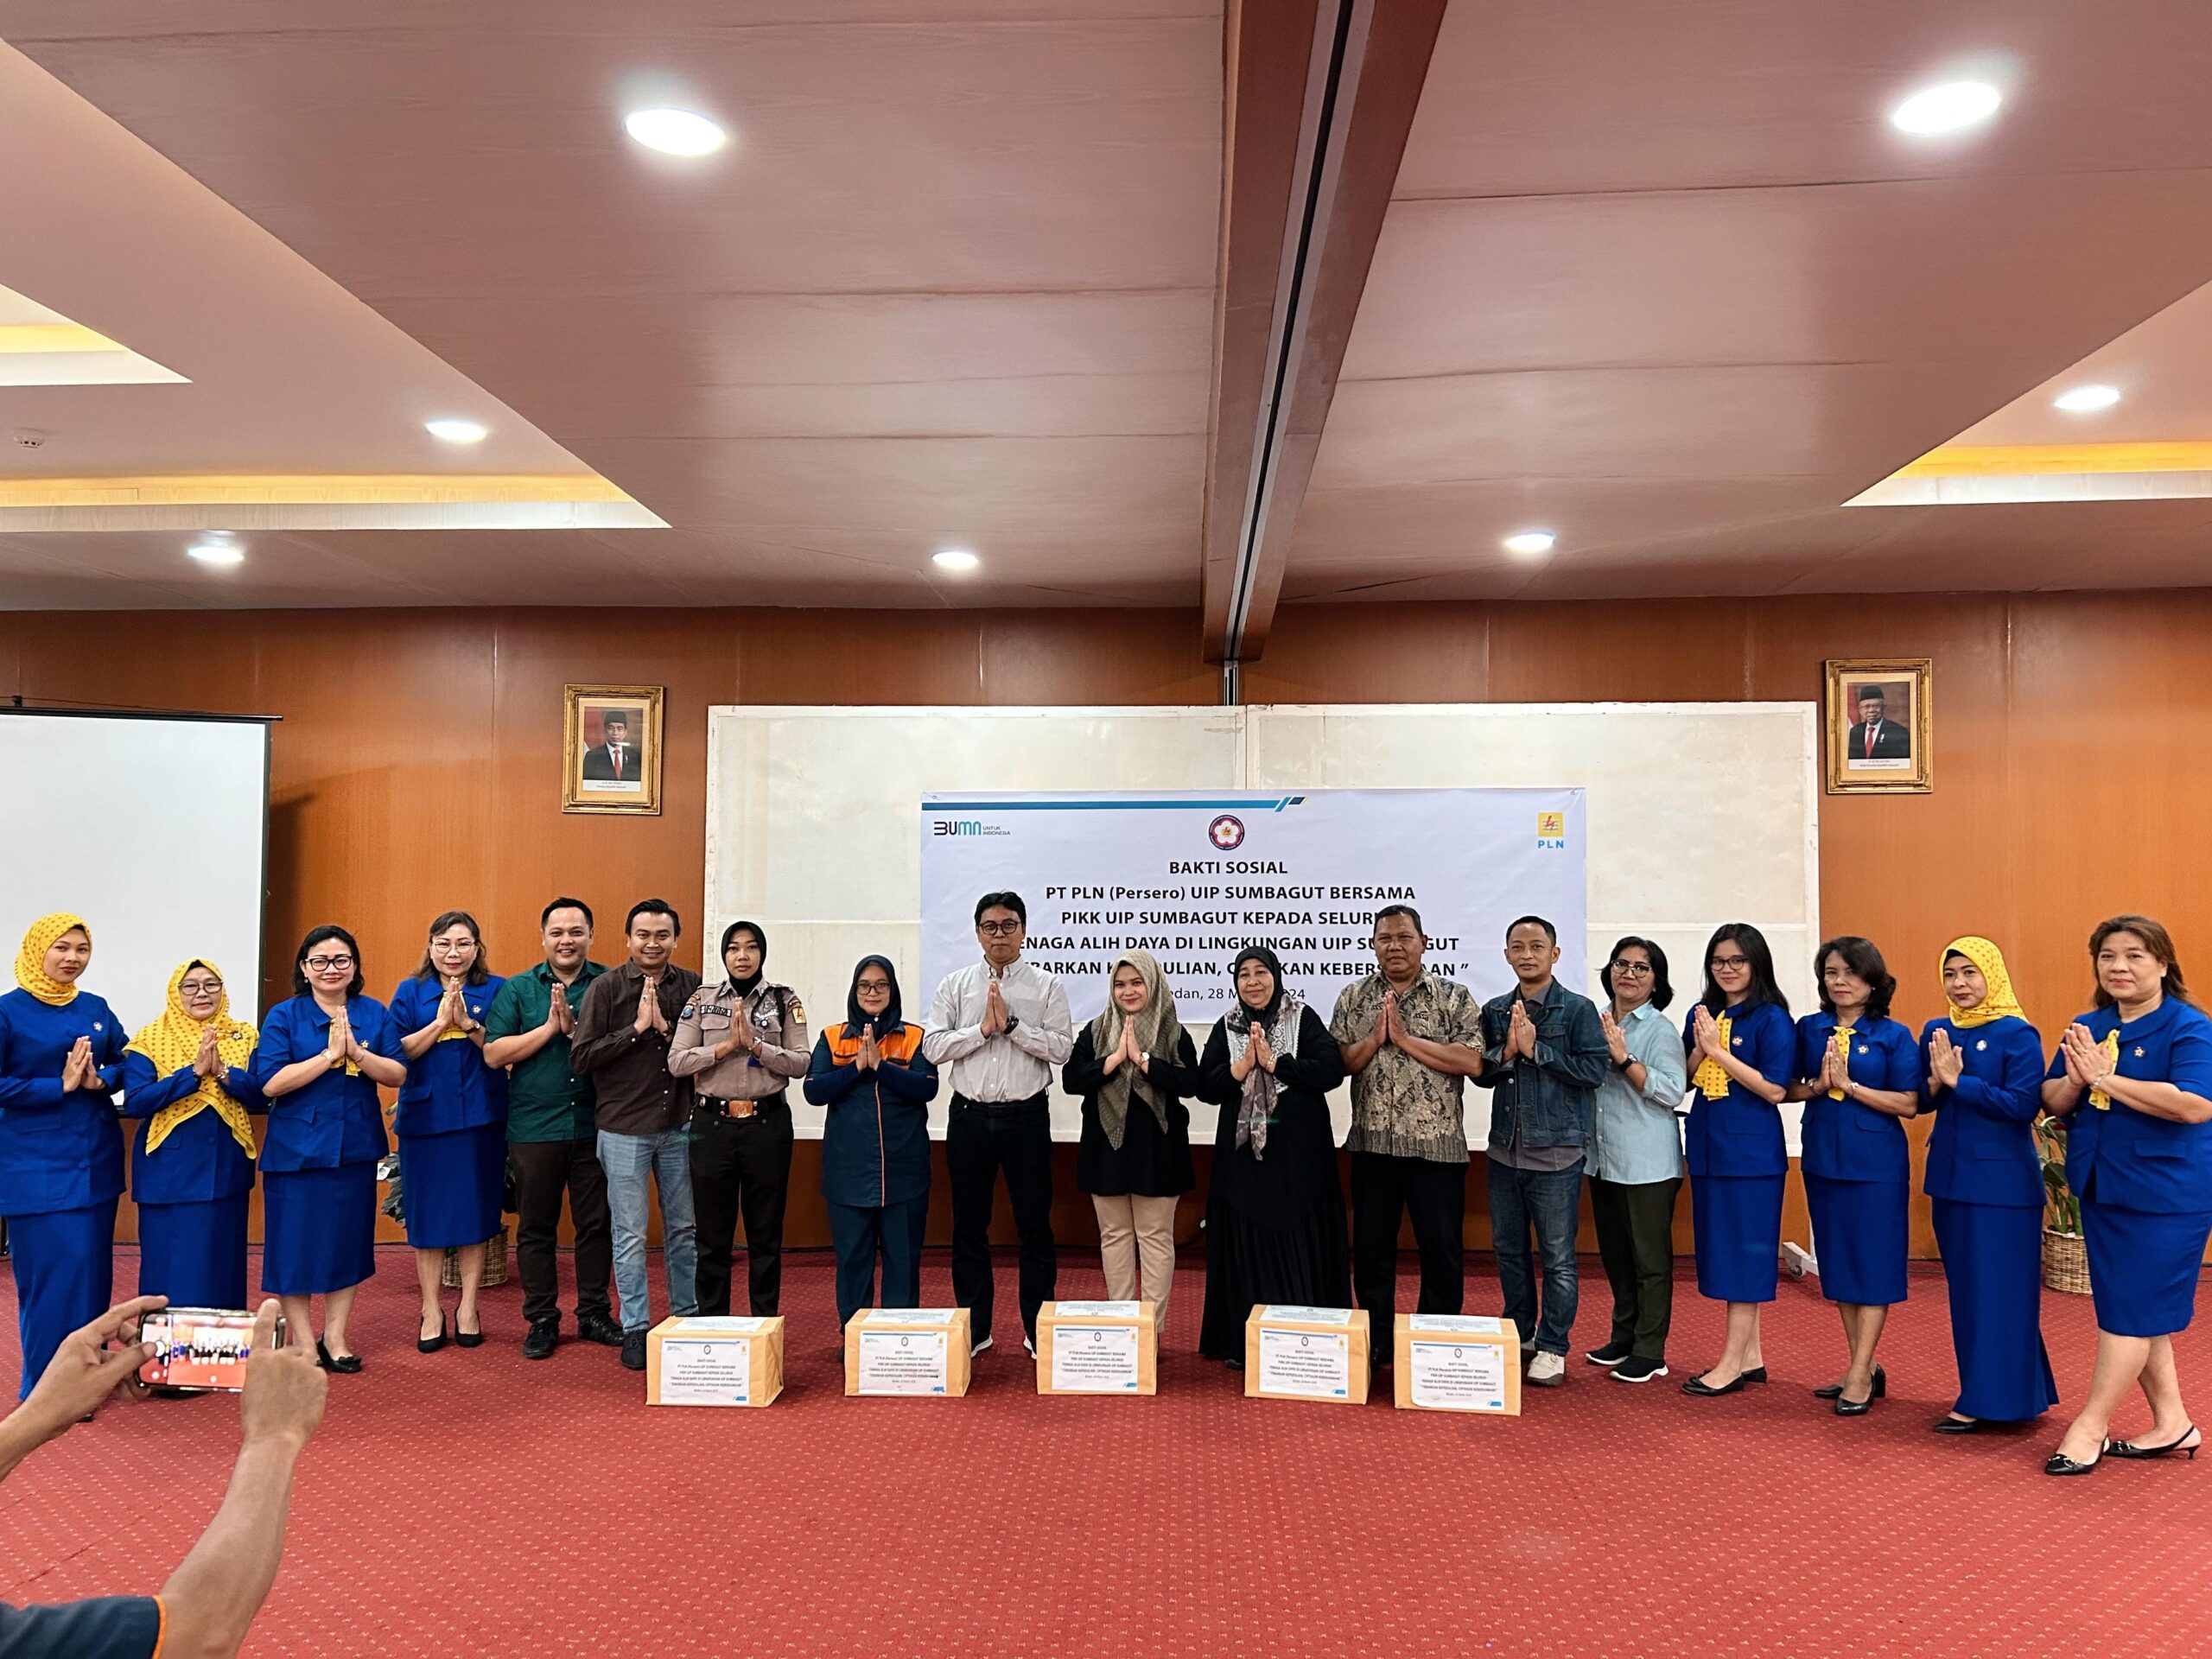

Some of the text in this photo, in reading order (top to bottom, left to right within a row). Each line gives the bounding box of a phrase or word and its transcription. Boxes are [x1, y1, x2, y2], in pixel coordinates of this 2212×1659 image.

[1537, 840, 1564, 849] PLN
[1169, 861, 1288, 874] BAKTI SOSIAL
[1046, 886, 1415, 901] PT PLN (Persero) UIP SUMBAGUT BERSAMA
[1061, 912, 1376, 925] PIKK UIP SUMBAGUT KEPADA SELUR
[1020, 937, 1075, 950] NAGA
[1080, 937, 1120, 950] ALIH
[1125, 937, 1170, 950] DAYA
[1175, 937, 1193, 950] DI
[1198, 937, 1317, 950] LINGKUNGAN
[1322, 938, 1351, 950] UIP
[1207, 988, 1224, 1000] 28
